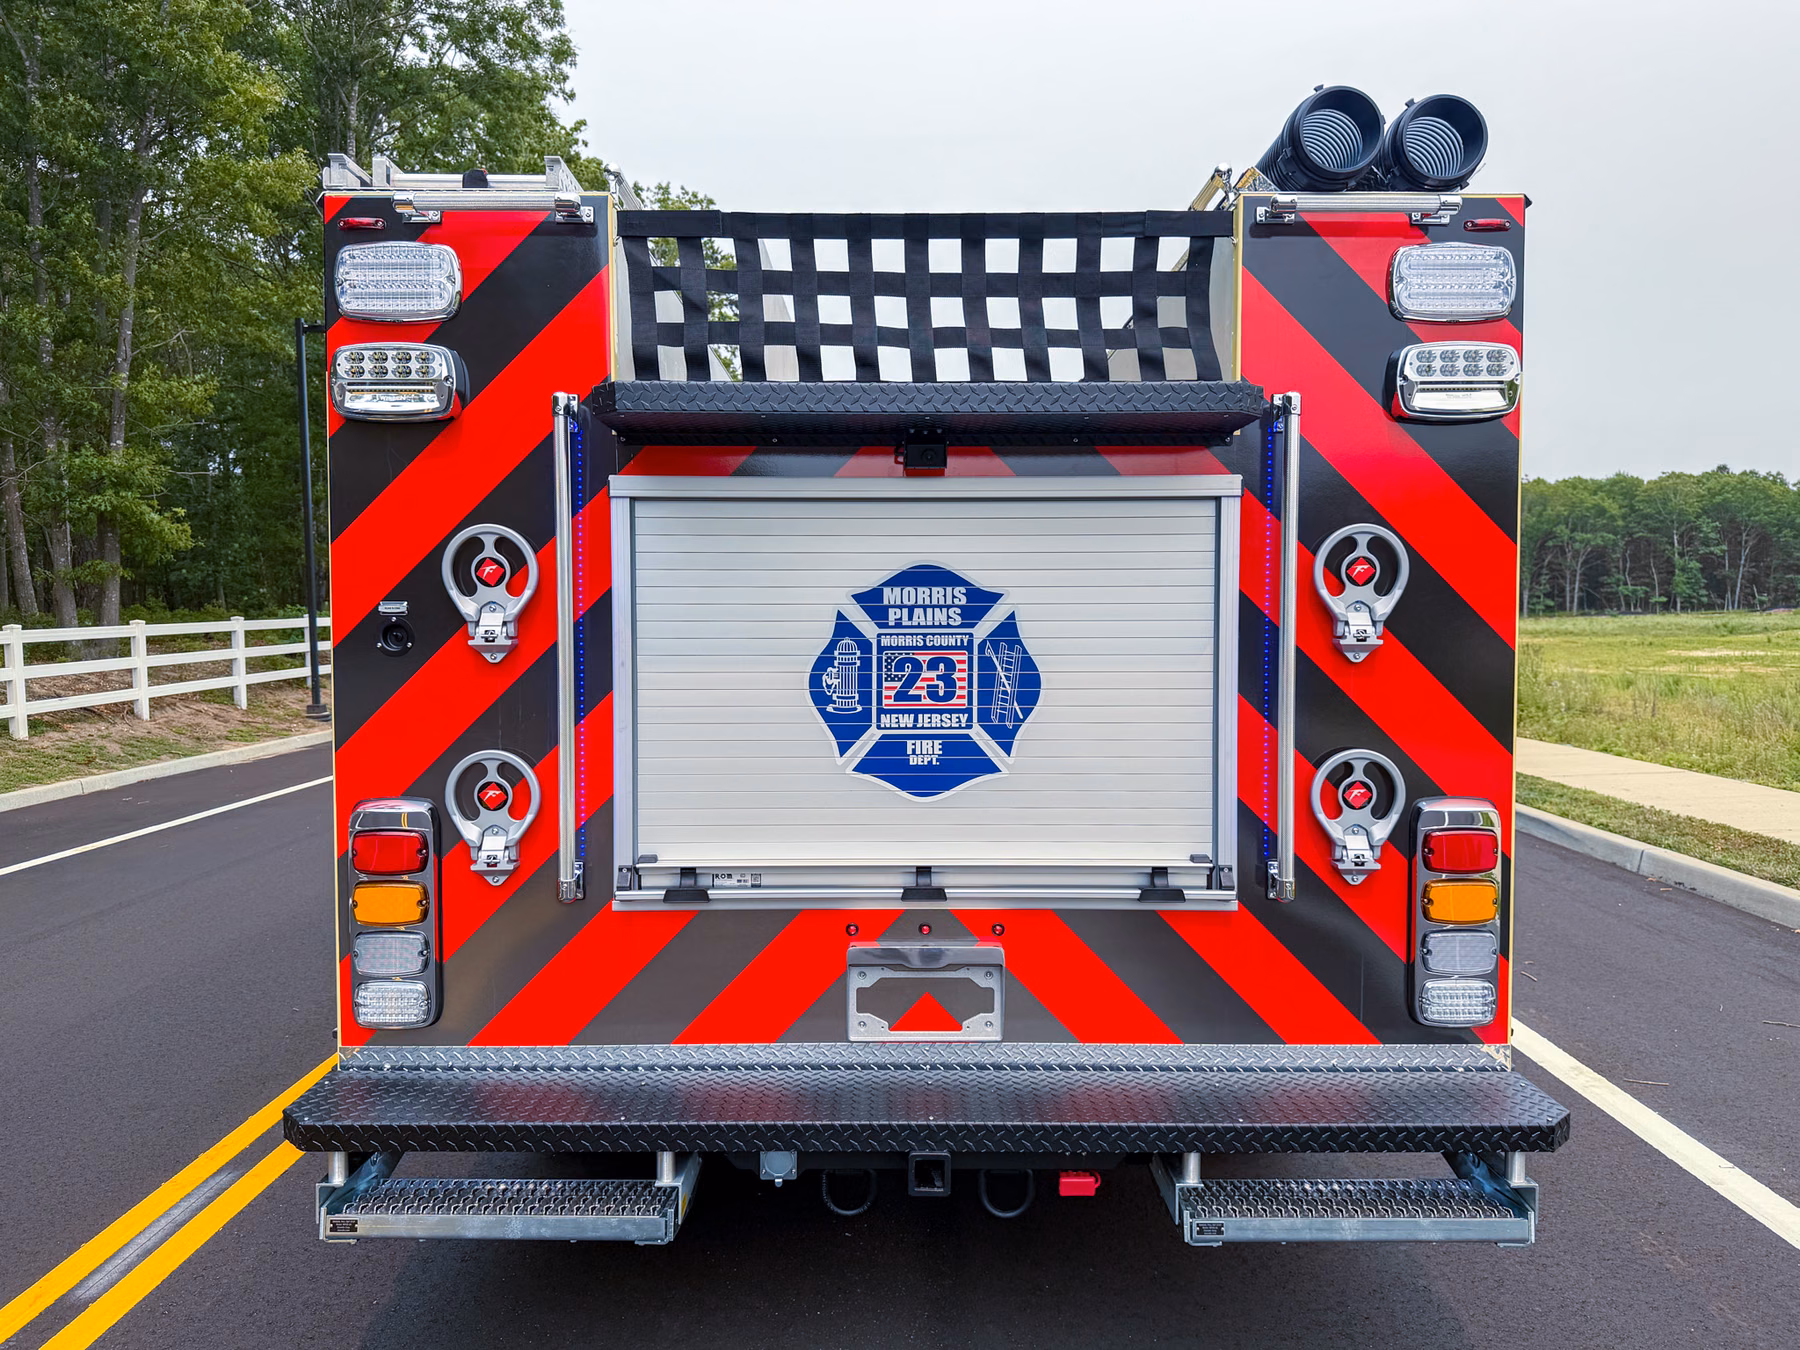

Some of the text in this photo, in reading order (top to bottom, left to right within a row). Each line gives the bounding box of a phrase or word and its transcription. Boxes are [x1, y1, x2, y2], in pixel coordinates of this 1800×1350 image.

[883, 587, 967, 605] MORRIS
[888, 607, 962, 626] PLAINS
[881, 635, 969, 647] MORRIS COUNTY
[892, 655, 958, 704] 23
[880, 714, 968, 728] NEW JERSEY
[906, 740, 943, 755] FIRE
[909, 755, 940, 765] DEPT.
